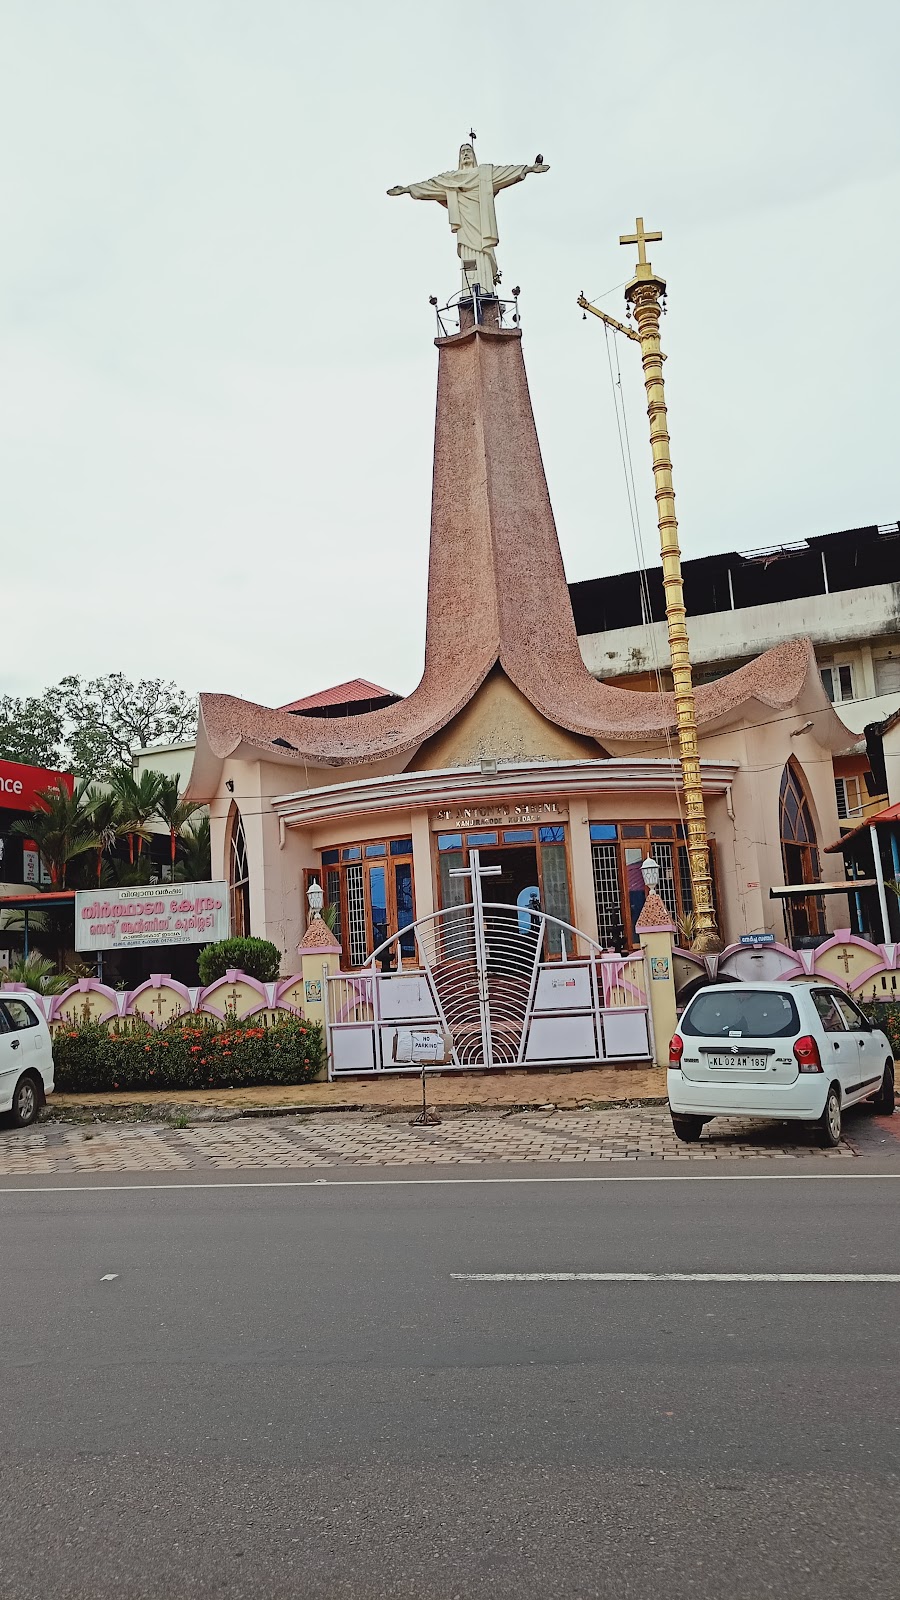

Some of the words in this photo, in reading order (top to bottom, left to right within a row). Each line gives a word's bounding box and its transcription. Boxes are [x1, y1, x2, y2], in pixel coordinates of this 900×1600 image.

[514, 802, 559, 815] SHRINE
[713, 1057, 723, 1066] KL
[725, 1057, 735, 1066] 02
[737, 1057, 747, 1066] AM
[751, 1058, 765, 1067] 185
